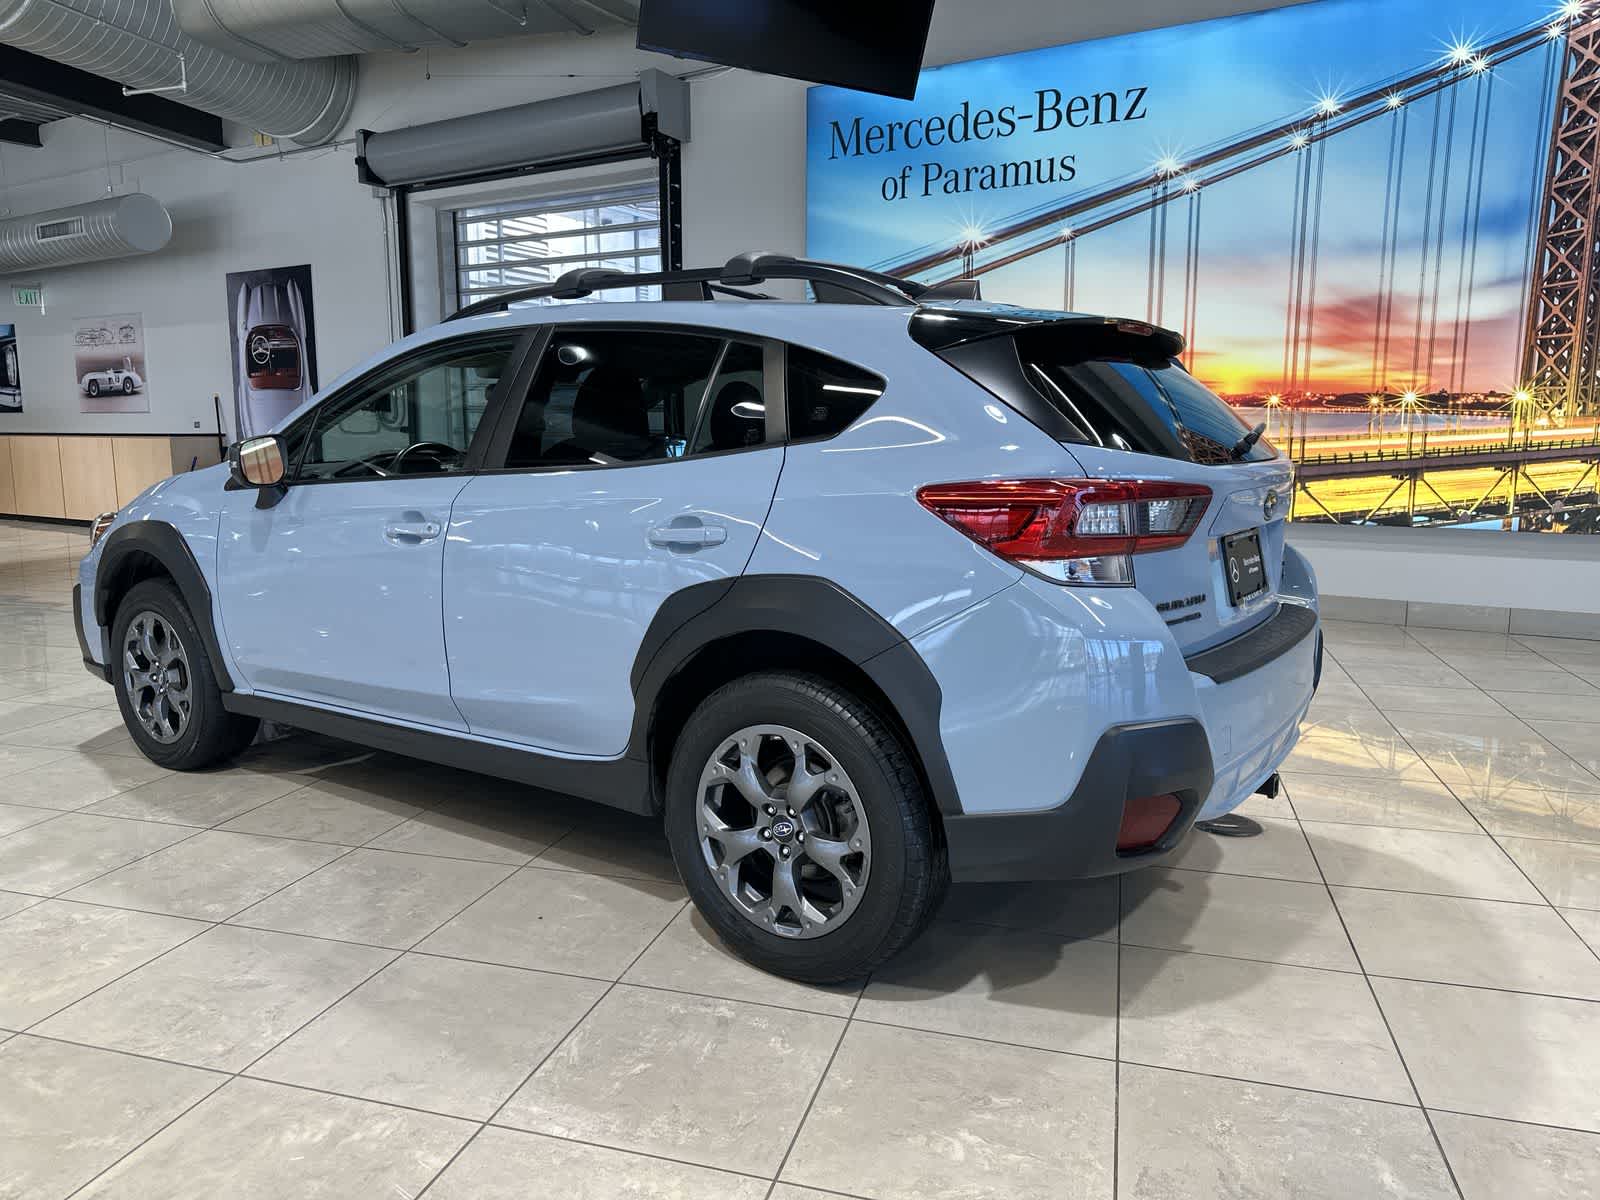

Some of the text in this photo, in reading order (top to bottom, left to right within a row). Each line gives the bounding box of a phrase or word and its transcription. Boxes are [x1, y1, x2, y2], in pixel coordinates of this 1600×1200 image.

[828, 86, 1148, 160] Mercedes-Benz
[881, 154, 1076, 201] of Paramus
[18, 289, 38, 305] EXIT
